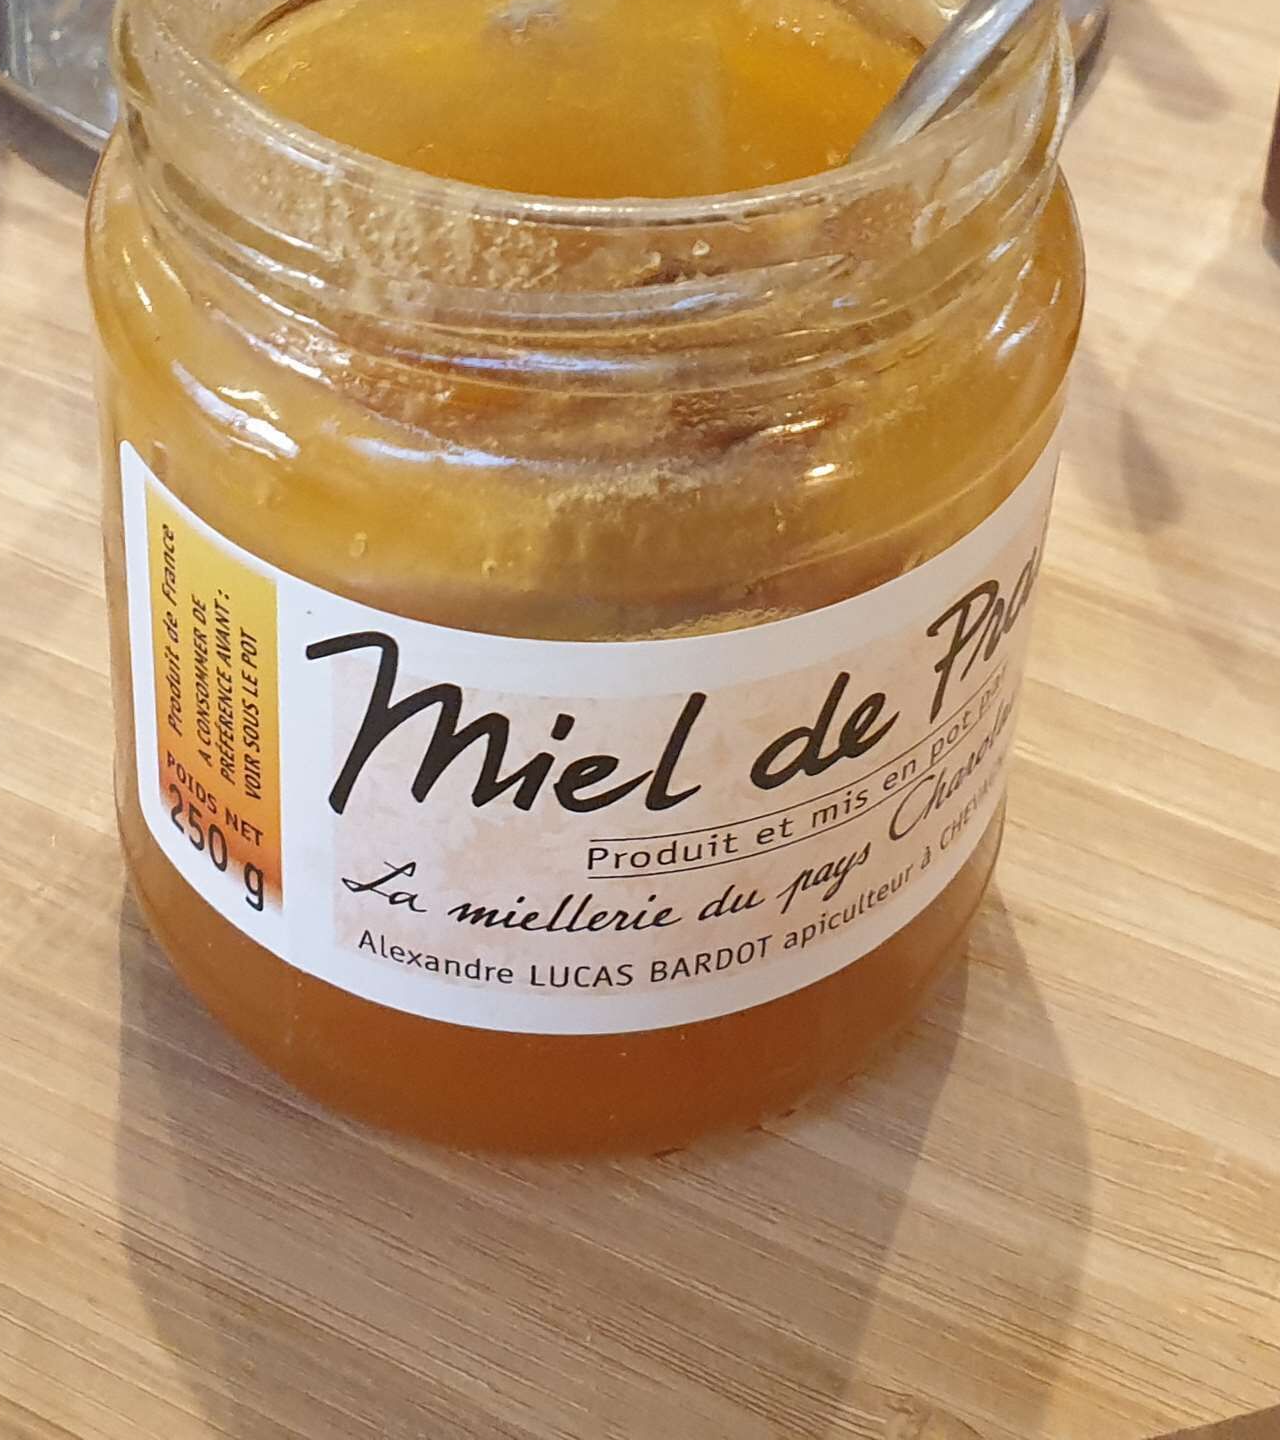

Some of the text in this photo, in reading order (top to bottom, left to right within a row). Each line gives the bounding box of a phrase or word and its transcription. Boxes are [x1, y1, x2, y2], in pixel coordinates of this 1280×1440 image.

[162, 523, 183, 738] Produit de France
[191, 594, 213, 768] A CONSOMMER DE
[240, 627, 262, 800] VOIR SOUS LE POT
[305, 630, 706, 816] Miel
[750, 671, 900, 790] de
[588, 830, 738, 872] Produit
[756, 817, 794, 846] et
[811, 786, 869, 830] mis
[882, 758, 917, 792] en
[930, 709, 971, 763] pot
[167, 750, 264, 847] POIDS NET
[168, 784, 228, 872] 250
[341, 860, 427, 913] La
[447, 893, 682, 933] miellerie
[698, 885, 766, 922] du
[776, 841, 872, 915] pays
[358, 930, 514, 984] Alexandre
[530, 963, 634, 989] LUCAS
[649, 934, 773, 983] BARDOT
[783, 862, 915, 950] apiculteur
[920, 845, 932, 871] à
